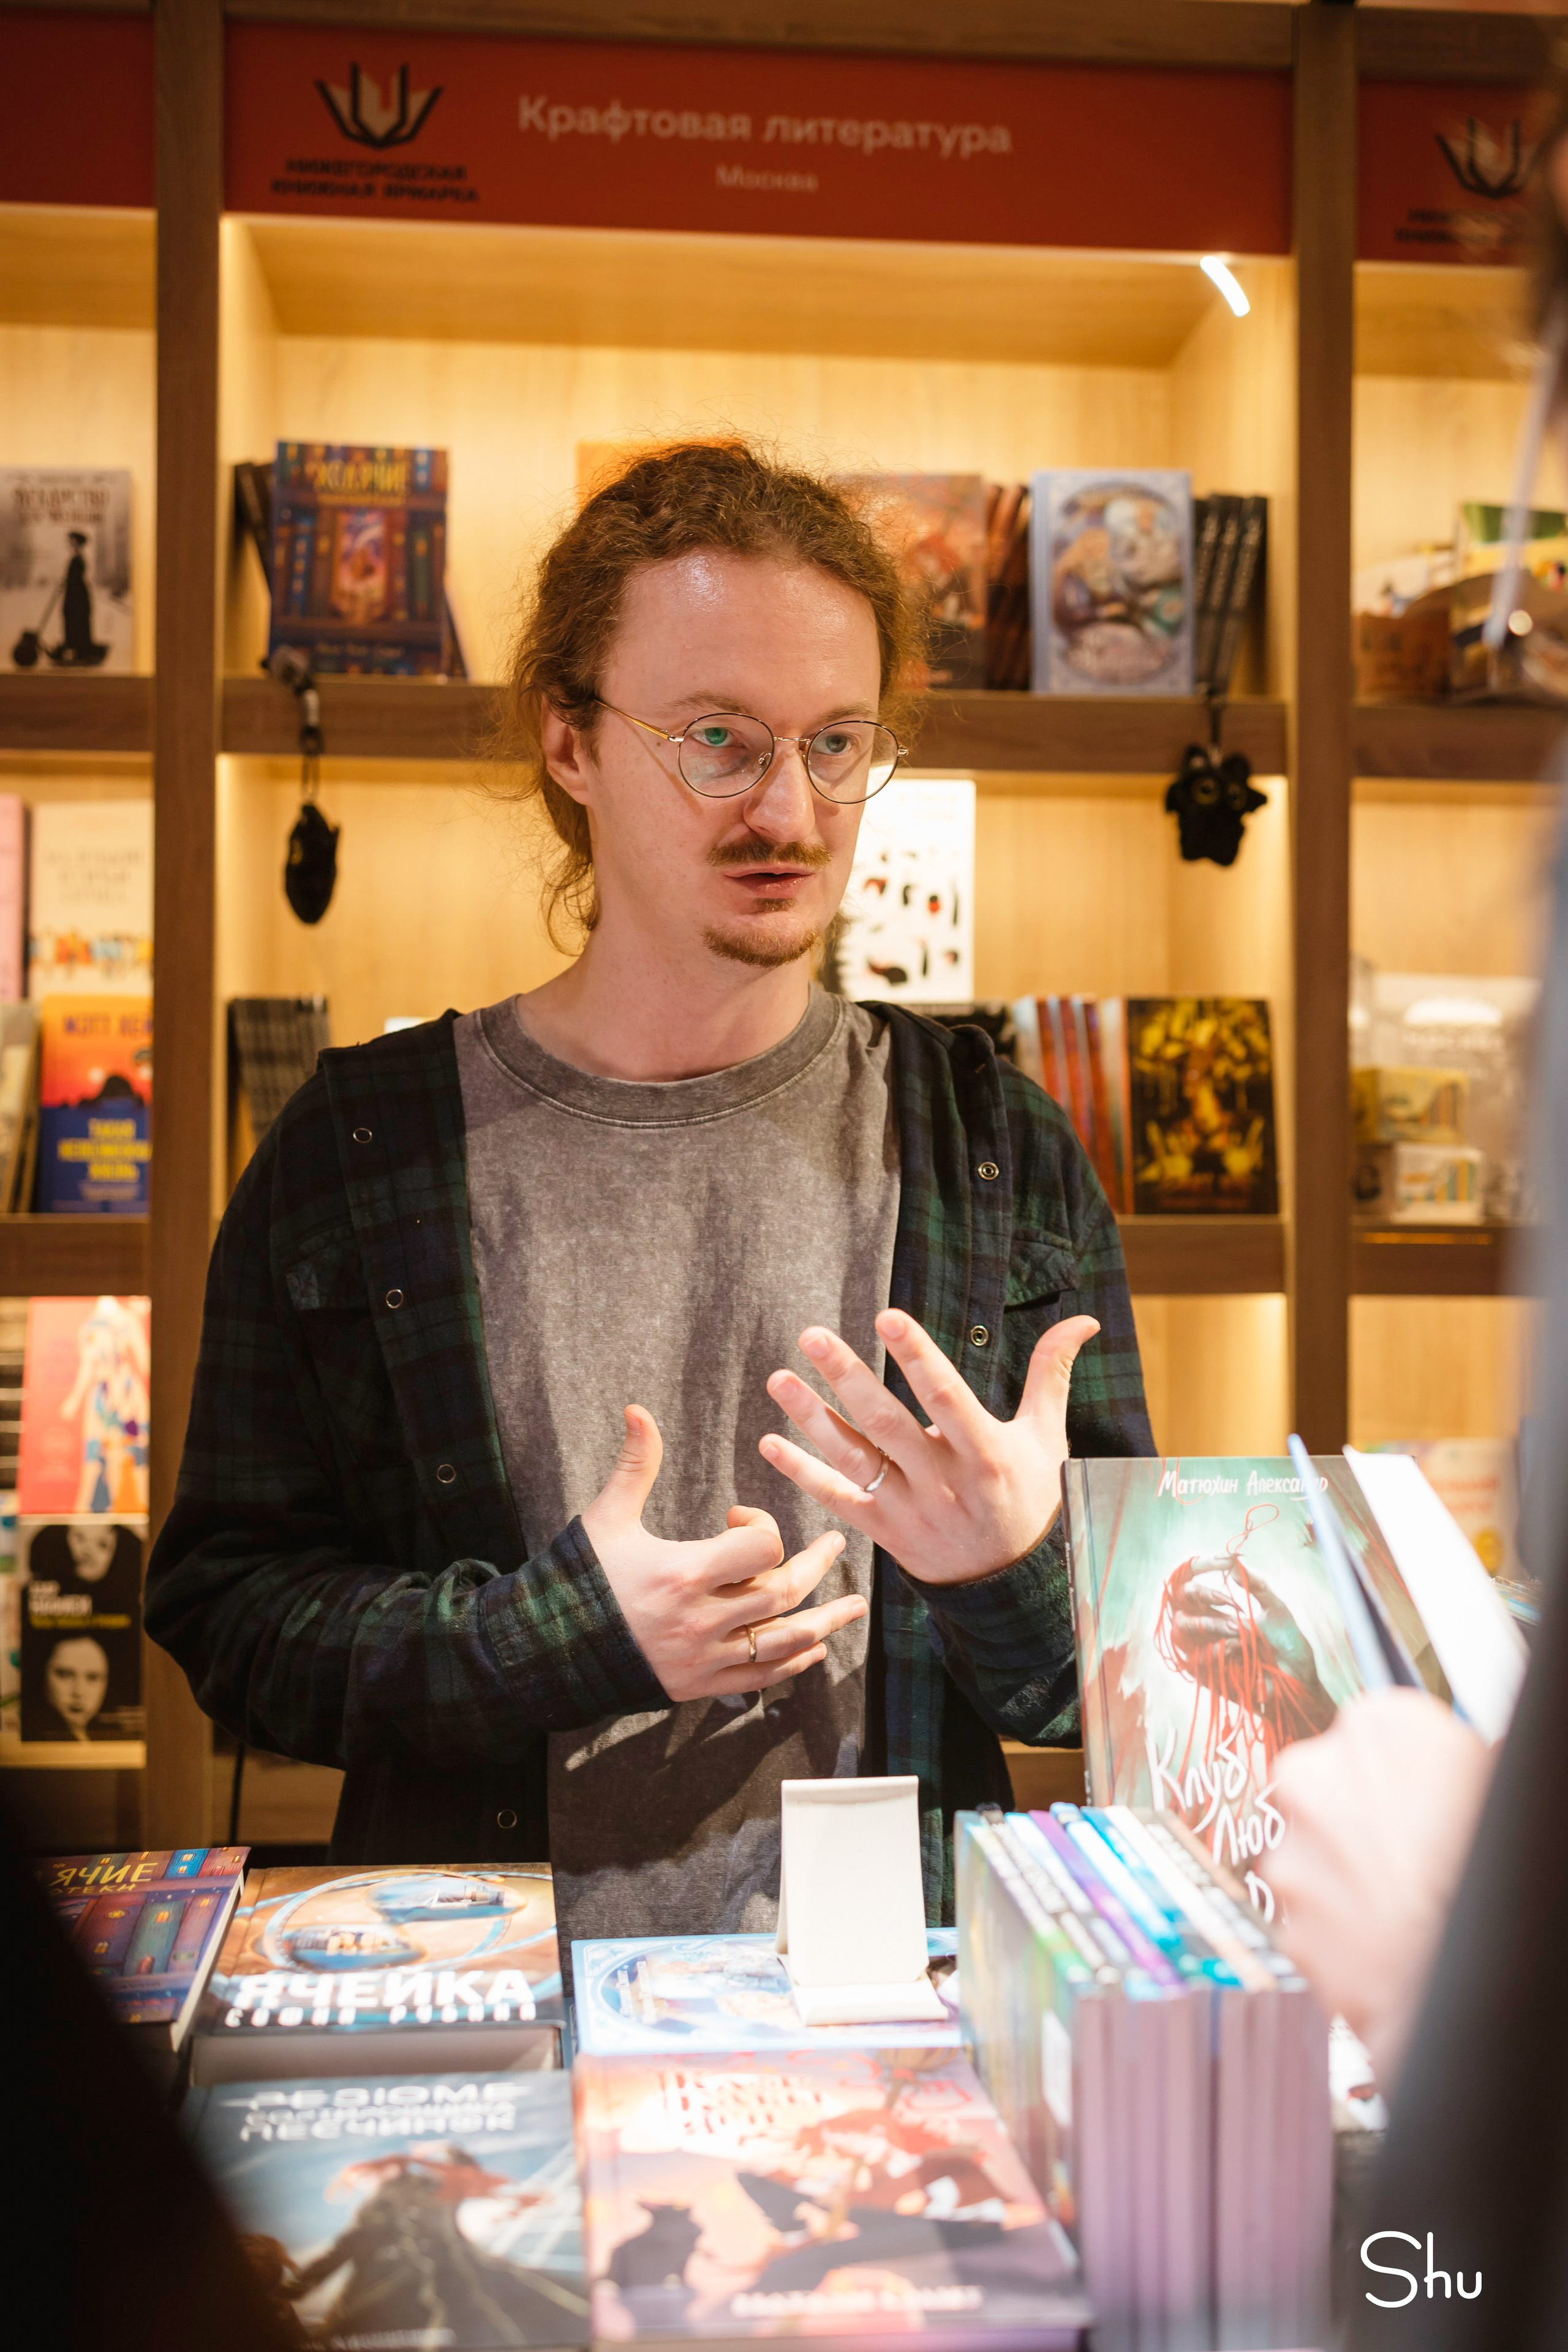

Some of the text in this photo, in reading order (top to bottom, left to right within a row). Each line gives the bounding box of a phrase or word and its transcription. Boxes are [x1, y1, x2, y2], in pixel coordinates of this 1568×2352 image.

[518, 94, 1013, 159] Крафтовая литература
[715, 164, 818, 191] Москва
[1157, 1469, 1238, 1498] Матюхин
[1144, 1717, 1248, 1834] Клуб
[232, 1967, 537, 2010] ЯЧЕЙКА
